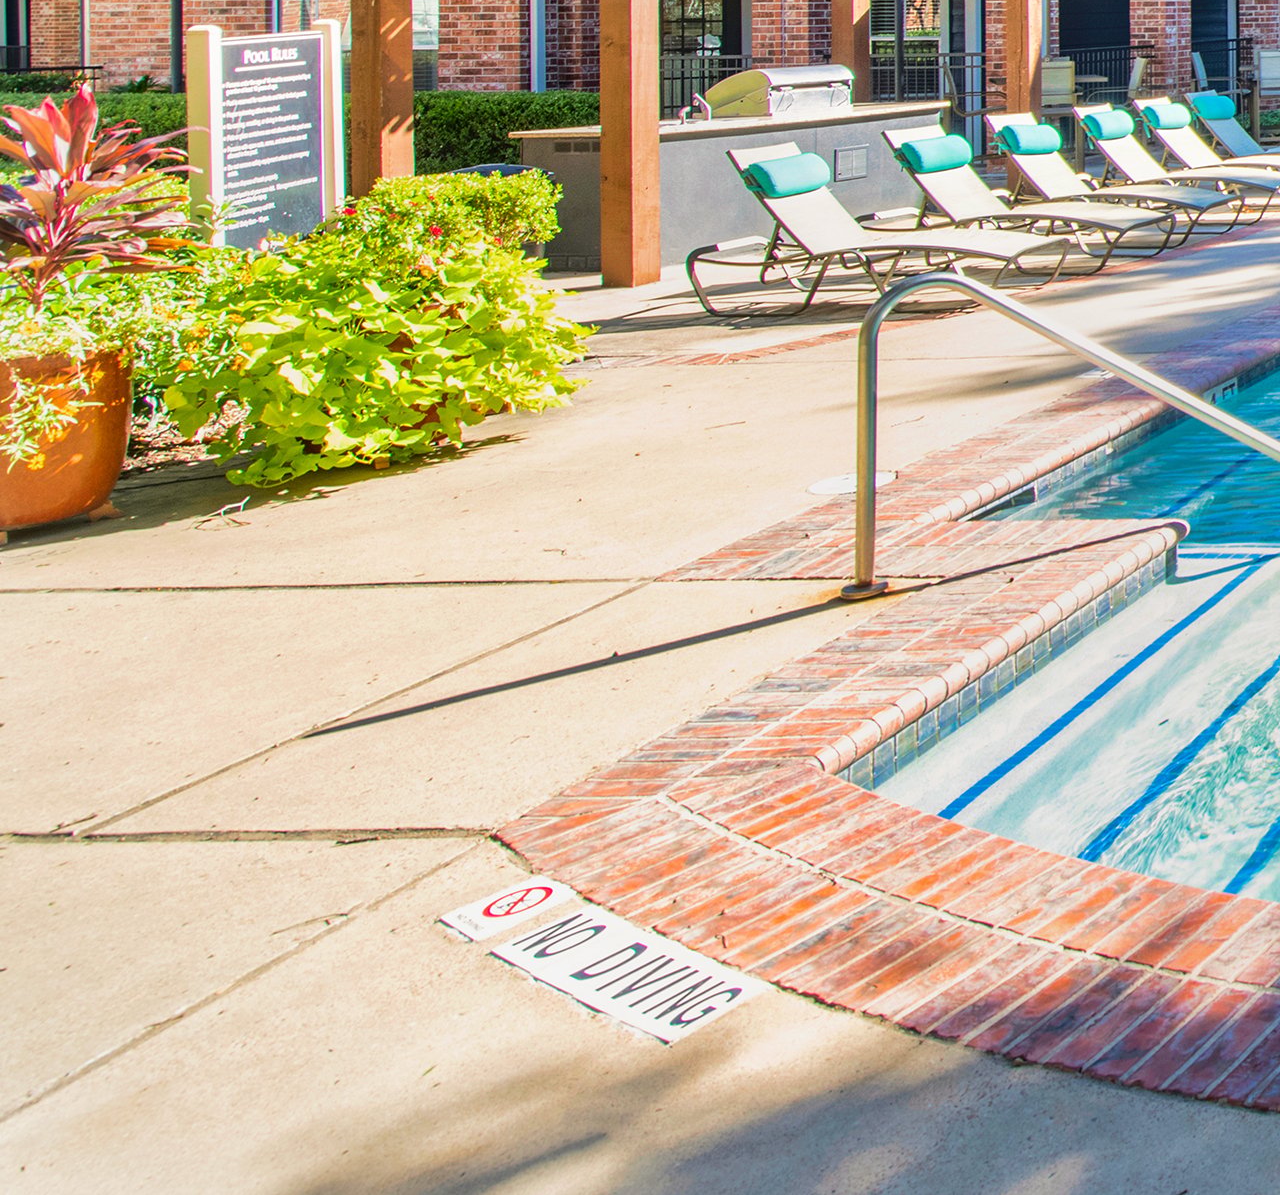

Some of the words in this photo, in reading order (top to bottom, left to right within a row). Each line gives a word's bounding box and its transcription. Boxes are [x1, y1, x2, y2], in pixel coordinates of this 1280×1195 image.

[243, 49, 270, 65] POOL
[271, 47, 298, 61] RULES
[1222, 382, 1236, 401] FT
[512, 913, 607, 959] NO
[569, 941, 743, 1029] DIVING
